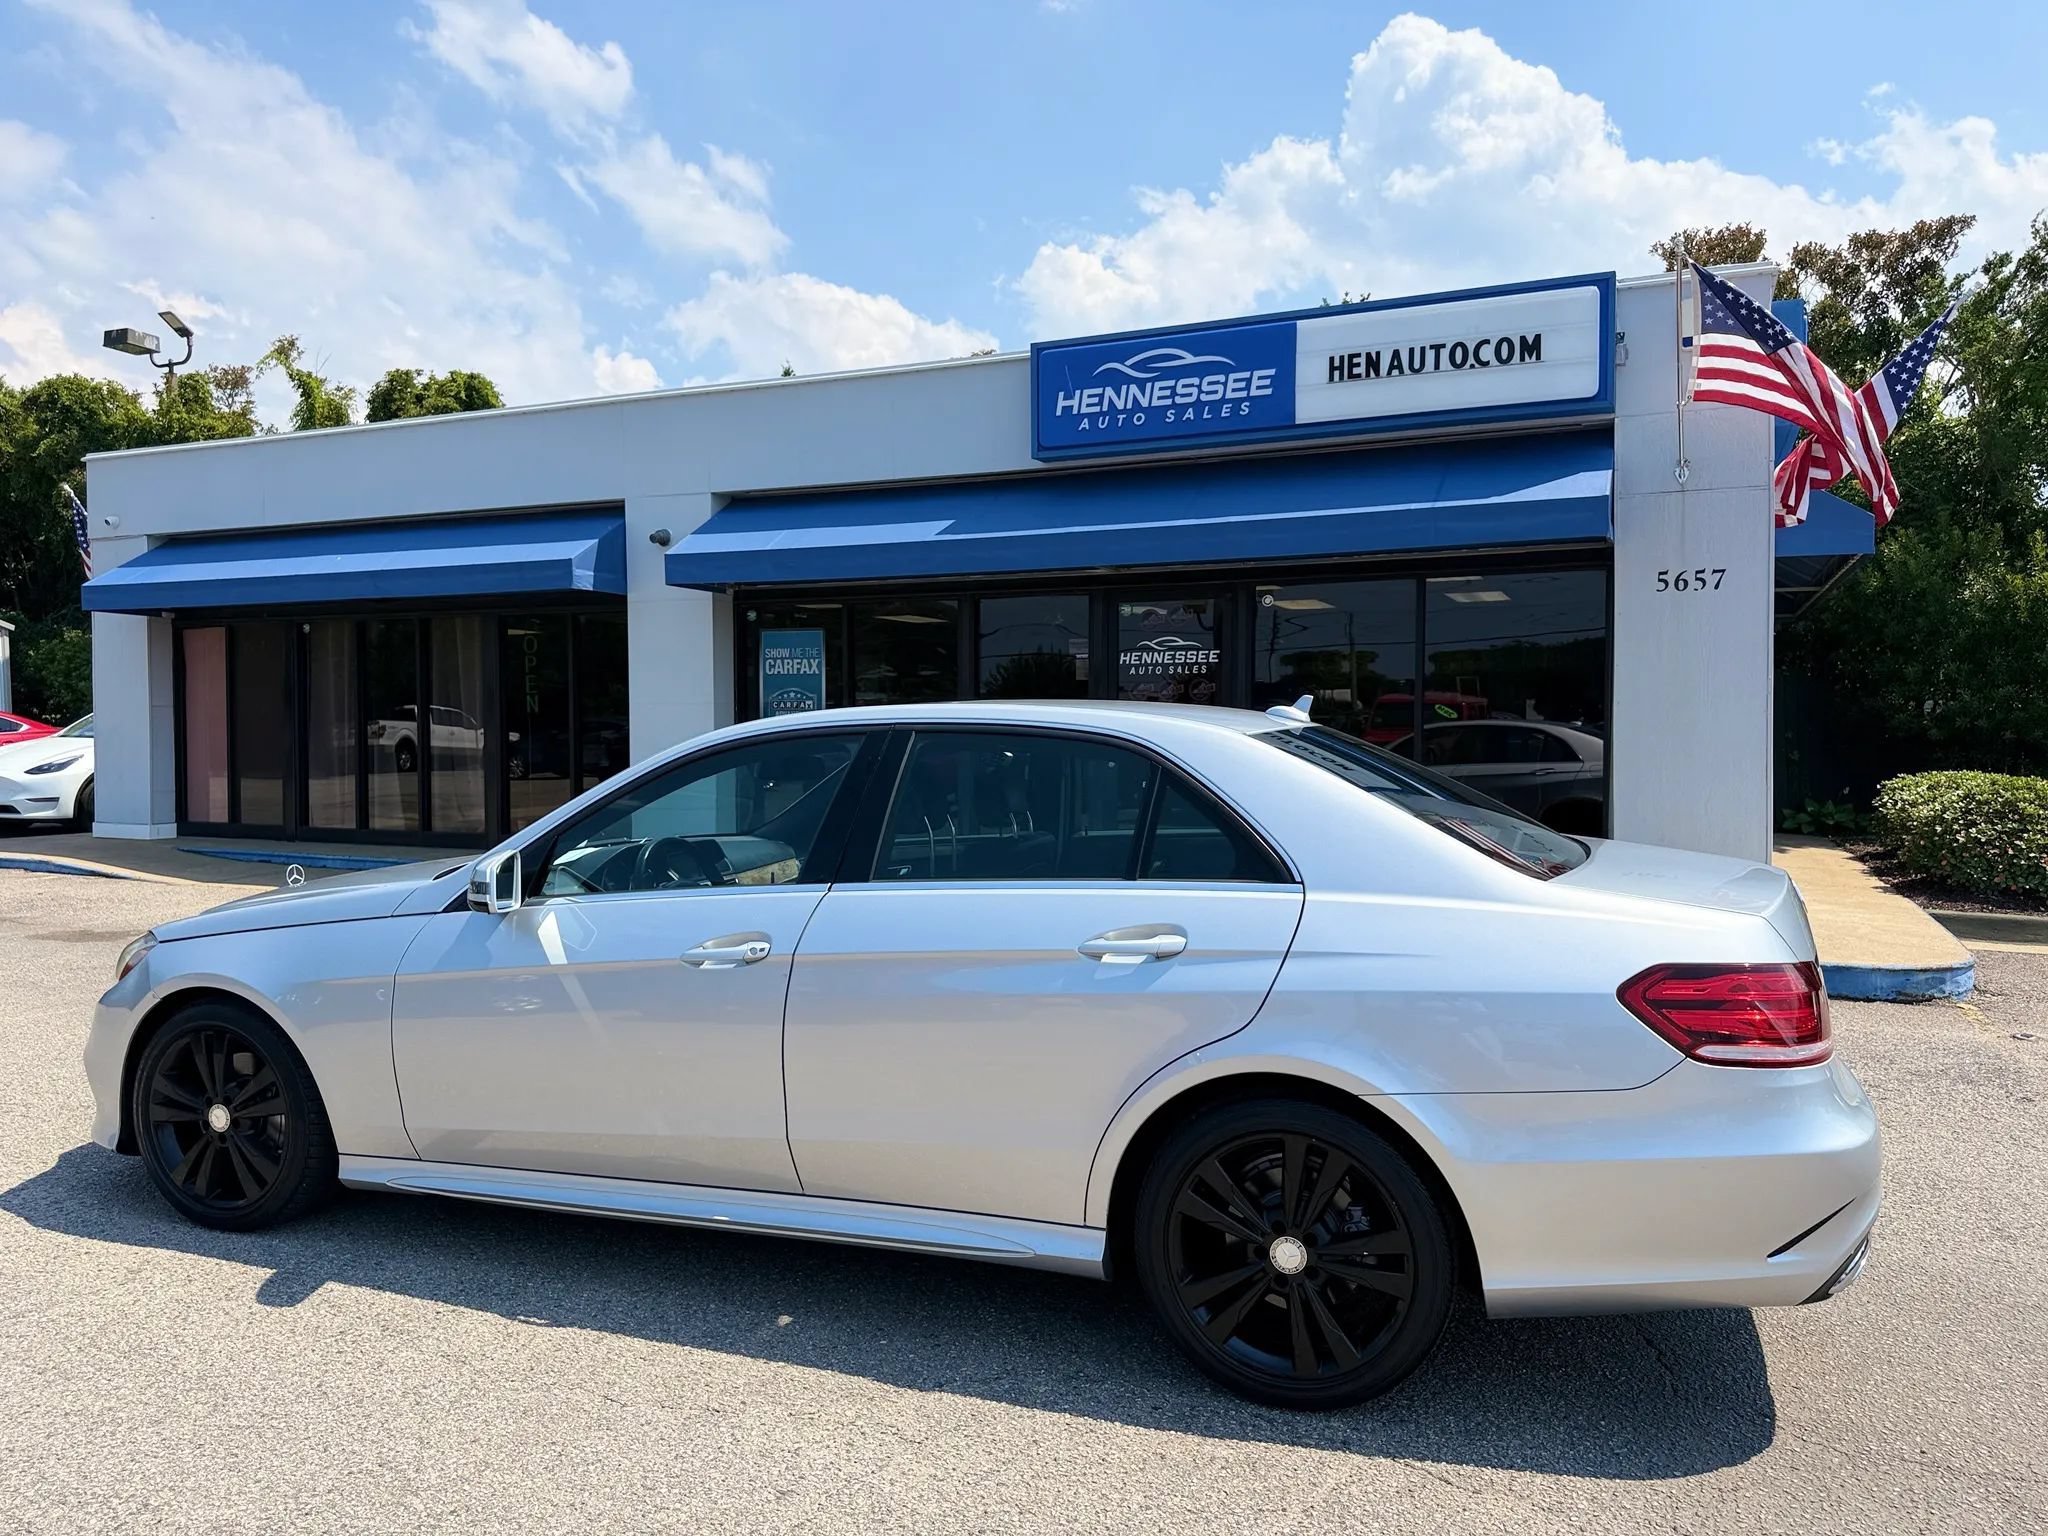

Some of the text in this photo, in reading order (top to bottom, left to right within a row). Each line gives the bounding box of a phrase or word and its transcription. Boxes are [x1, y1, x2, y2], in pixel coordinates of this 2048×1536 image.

[1055, 368, 1277, 417] HENNESSEE
[1078, 401, 1251, 431] AUTO SALES
[1655, 567, 1727, 593] 5657
[764, 647, 820, 659] SHOW ME THE
[1119, 650, 1221, 665] HENNESSEE
[523, 635, 539, 713] OPEN
[765, 659, 820, 675] CARFAX
[1129, 665, 1208, 675] AUTO SALES
[772, 700, 814, 710] CARFAX
